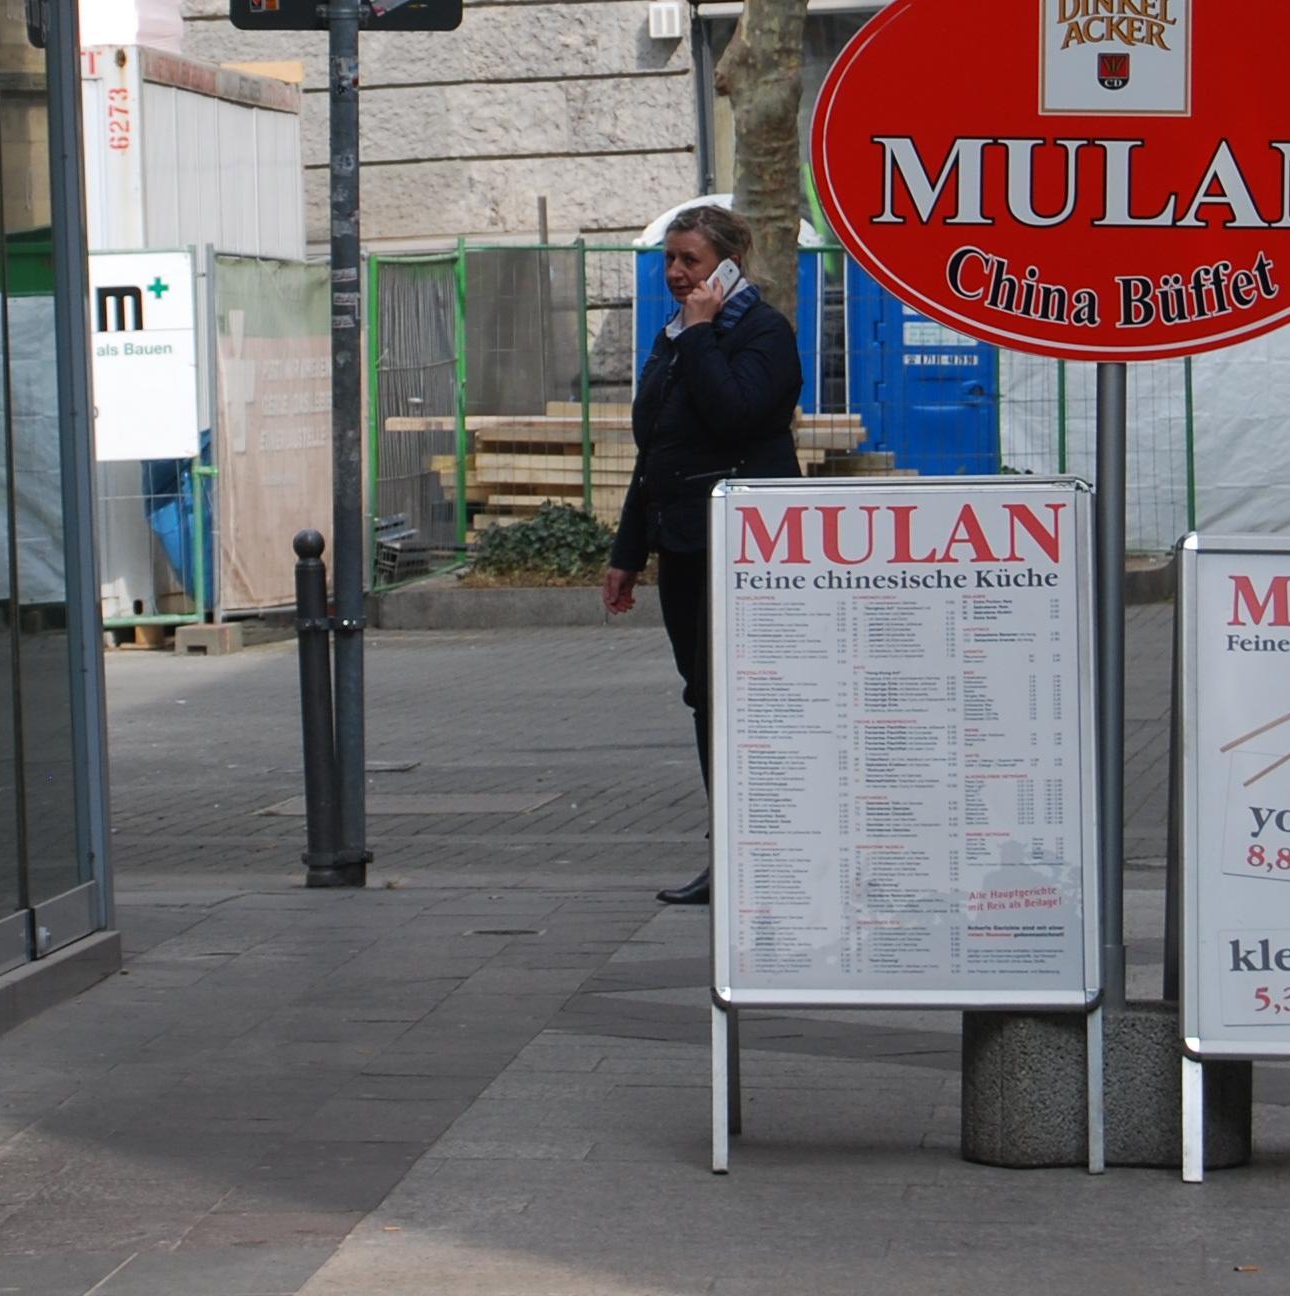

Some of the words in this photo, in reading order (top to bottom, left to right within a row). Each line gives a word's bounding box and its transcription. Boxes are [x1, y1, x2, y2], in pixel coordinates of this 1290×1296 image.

[1060, 16, 1171, 51] ACKER
[109, 88, 129, 151] 6273
[945, 245, 1100, 328] China
[1115, 250, 1279, 329] Büffet
[96, 344, 118, 357] als
[124, 342, 173, 356] Bauen
[733, 503, 1067, 565] MULAN
[734, 571, 807, 590] Feine
[813, 570, 968, 590] chinesische
[975, 569, 1060, 589] Küche
[1226, 634, 1290, 653] Feine
